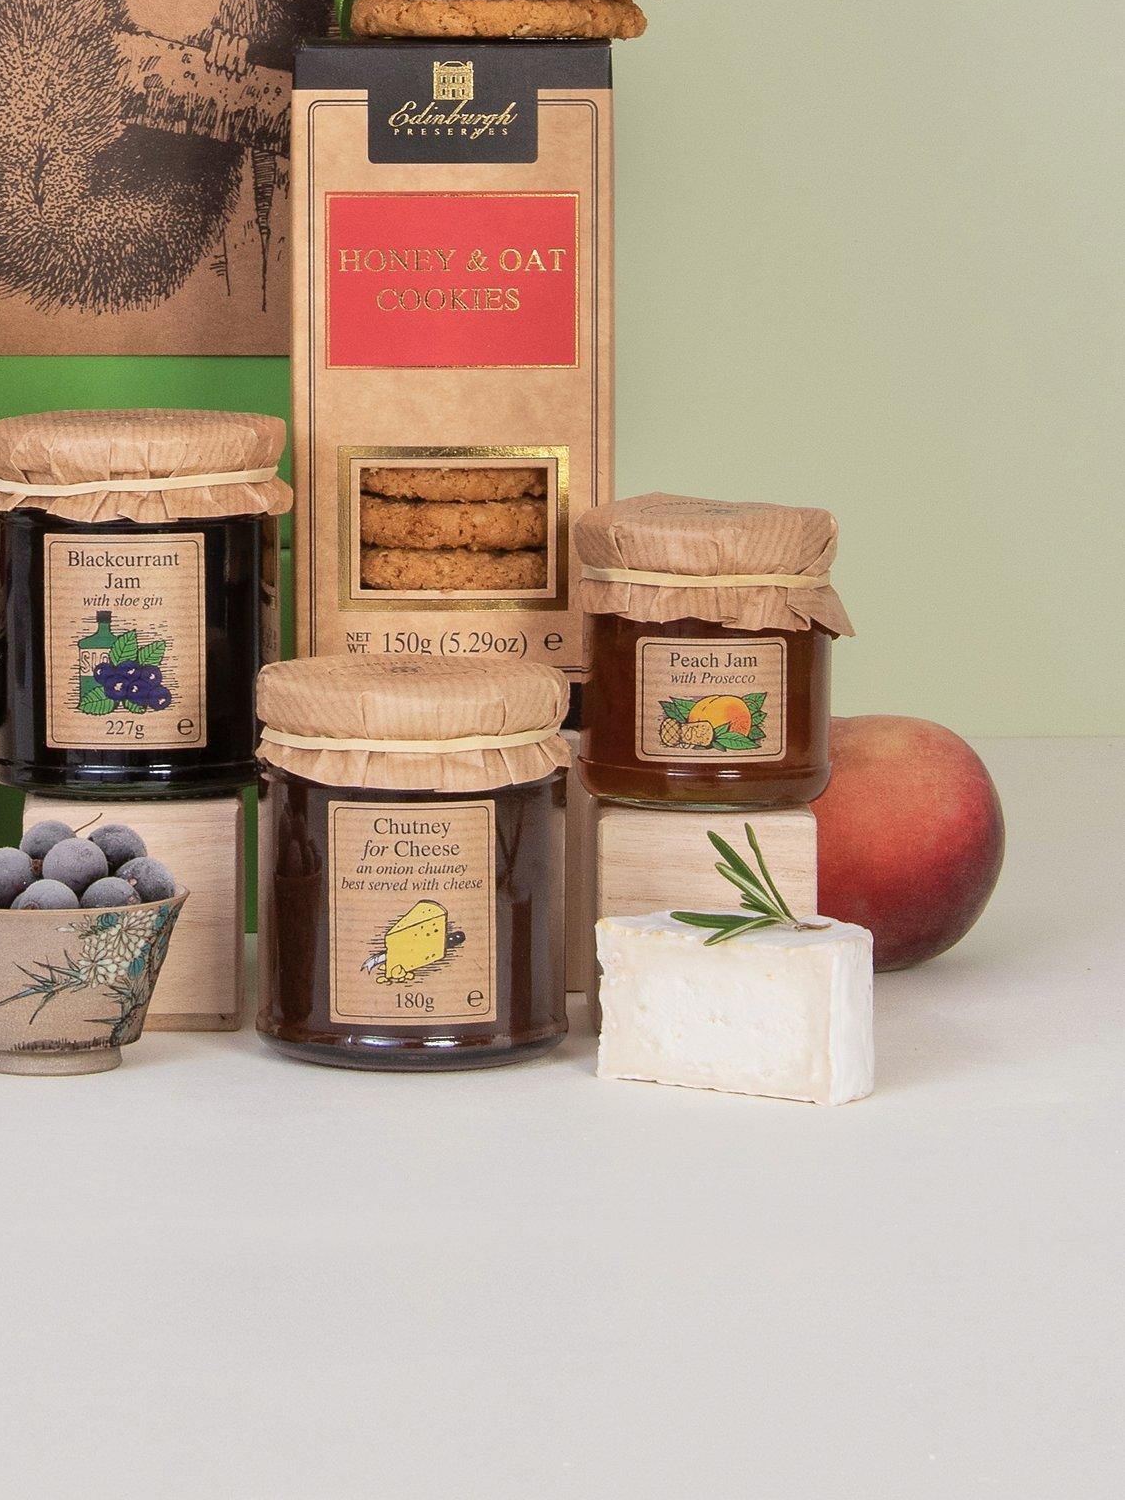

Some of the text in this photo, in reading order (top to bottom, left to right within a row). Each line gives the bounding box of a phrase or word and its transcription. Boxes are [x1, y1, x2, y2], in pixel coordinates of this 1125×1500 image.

[388, 101, 518, 140] Edinburgh
[394, 128, 508, 136] PRESERVES
[339, 249, 566, 272] HONEY & OAT
[376, 288, 521, 311] COOKIES
[67, 550, 180, 567] Blackcurrant
[105, 573, 141, 589] Jam
[83, 594, 163, 609] with sloe gin
[345, 632, 372, 642] NET
[383, 632, 432, 655] 150g
[439, 631, 528, 659] (5.29oz)
[347, 643, 371, 654] WT.
[669, 652, 757, 668] Peach Jam
[670, 672, 755, 684] with Prosecco
[106, 720, 144, 739] 227g
[373, 818, 451, 838] Chutney
[361, 840, 460, 861] for Cheese
[356, 862, 468, 877] an onion chutney
[341, 877, 483, 891] best served with cheese
[395, 993, 434, 1012] 180g
